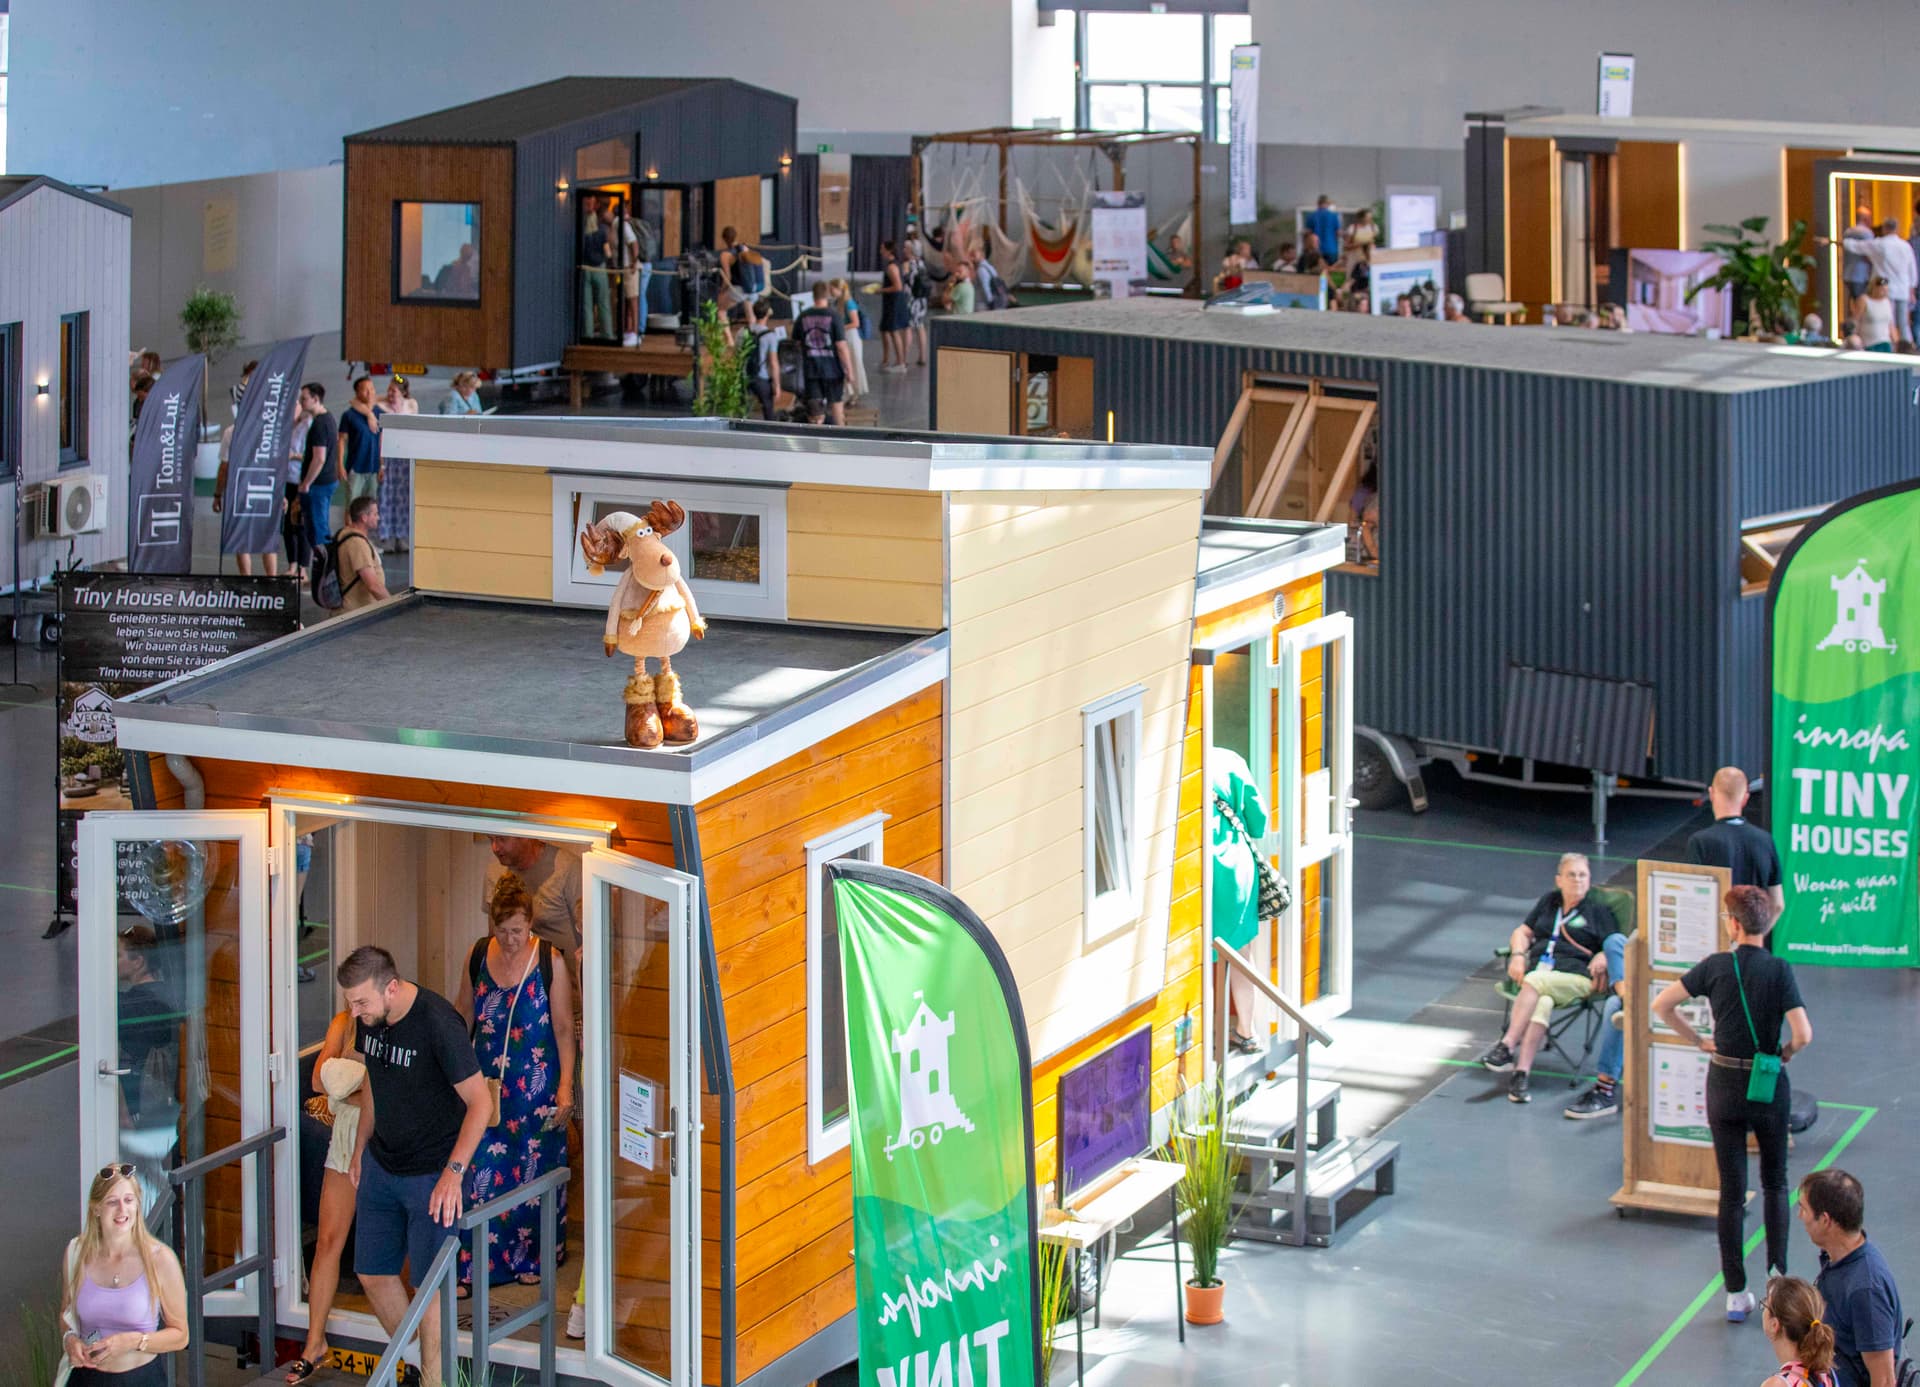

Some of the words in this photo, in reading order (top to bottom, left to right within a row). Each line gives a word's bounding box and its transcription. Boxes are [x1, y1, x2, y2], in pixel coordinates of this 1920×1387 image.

[255, 372, 285, 463] Tom&Luk
[156, 392, 181, 489] Tom&Luk
[74, 587, 112, 609] Tiny
[115, 588, 173, 606] House
[178, 590, 285, 610] Mobilheime
[109, 613, 158, 624] Genießen
[160, 614, 176, 625] Sie
[178, 615, 199, 625] Ihre
[201, 616, 246, 627] Freiheit,
[116, 627, 145, 637] leben
[147, 628, 163, 638] Sie
[165, 630, 181, 638] wo
[183, 629, 199, 639] Sie
[201, 630, 238, 640] wollen.
[125, 640, 143, 651] Wir
[145, 641, 177, 651] bauen
[180, 642, 198, 652] das
[200, 643, 230, 655] Haus,
[121, 655, 140, 664] von
[142, 655, 164, 665] dem
[166, 655, 183, 666] Sie
[185, 656, 222, 667] träum
[99, 666, 121, 679] Tiny
[122, 667, 154, 678] house
[158, 669, 178, 679] und
[76, 713, 116, 723] VEGAS
[1792, 768, 1910, 820] TINY
[1791, 824, 1908, 858] HOUSES
[1793, 872, 1850, 893] Wonen
[1854, 875, 1898, 889] waar
[1819, 897, 1836, 924] je
[1840, 891, 1877, 914] wilt
